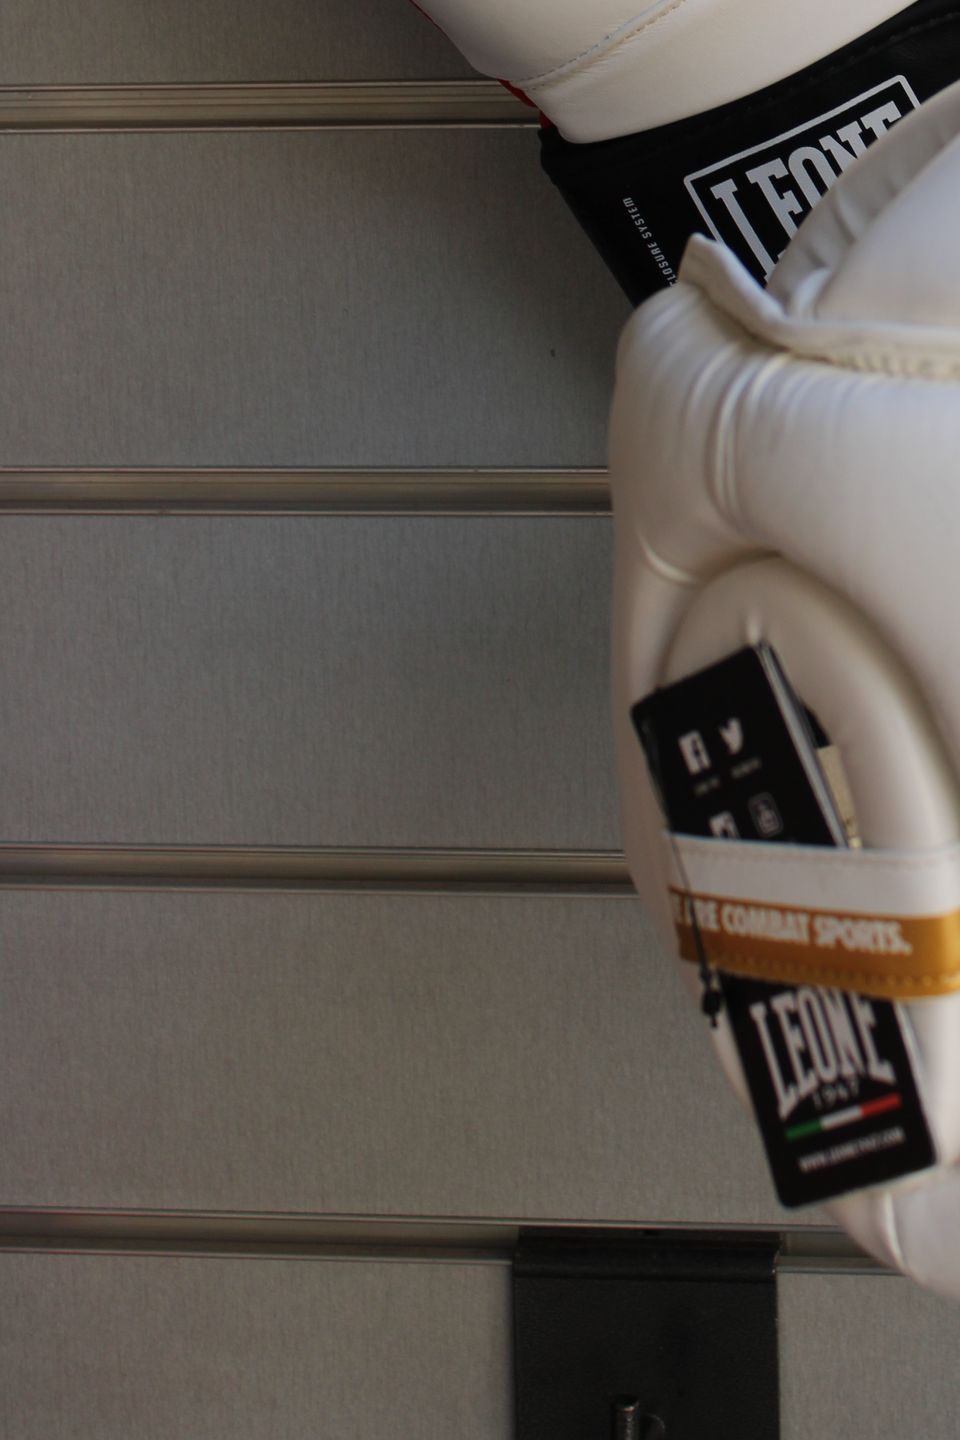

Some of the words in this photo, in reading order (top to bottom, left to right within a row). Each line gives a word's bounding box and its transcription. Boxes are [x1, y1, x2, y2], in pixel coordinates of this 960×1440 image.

[622, 197, 652, 239] SYSTEM
[720, 903, 810, 945] COMBAT
[749, 984, 897, 1122] LEONE
